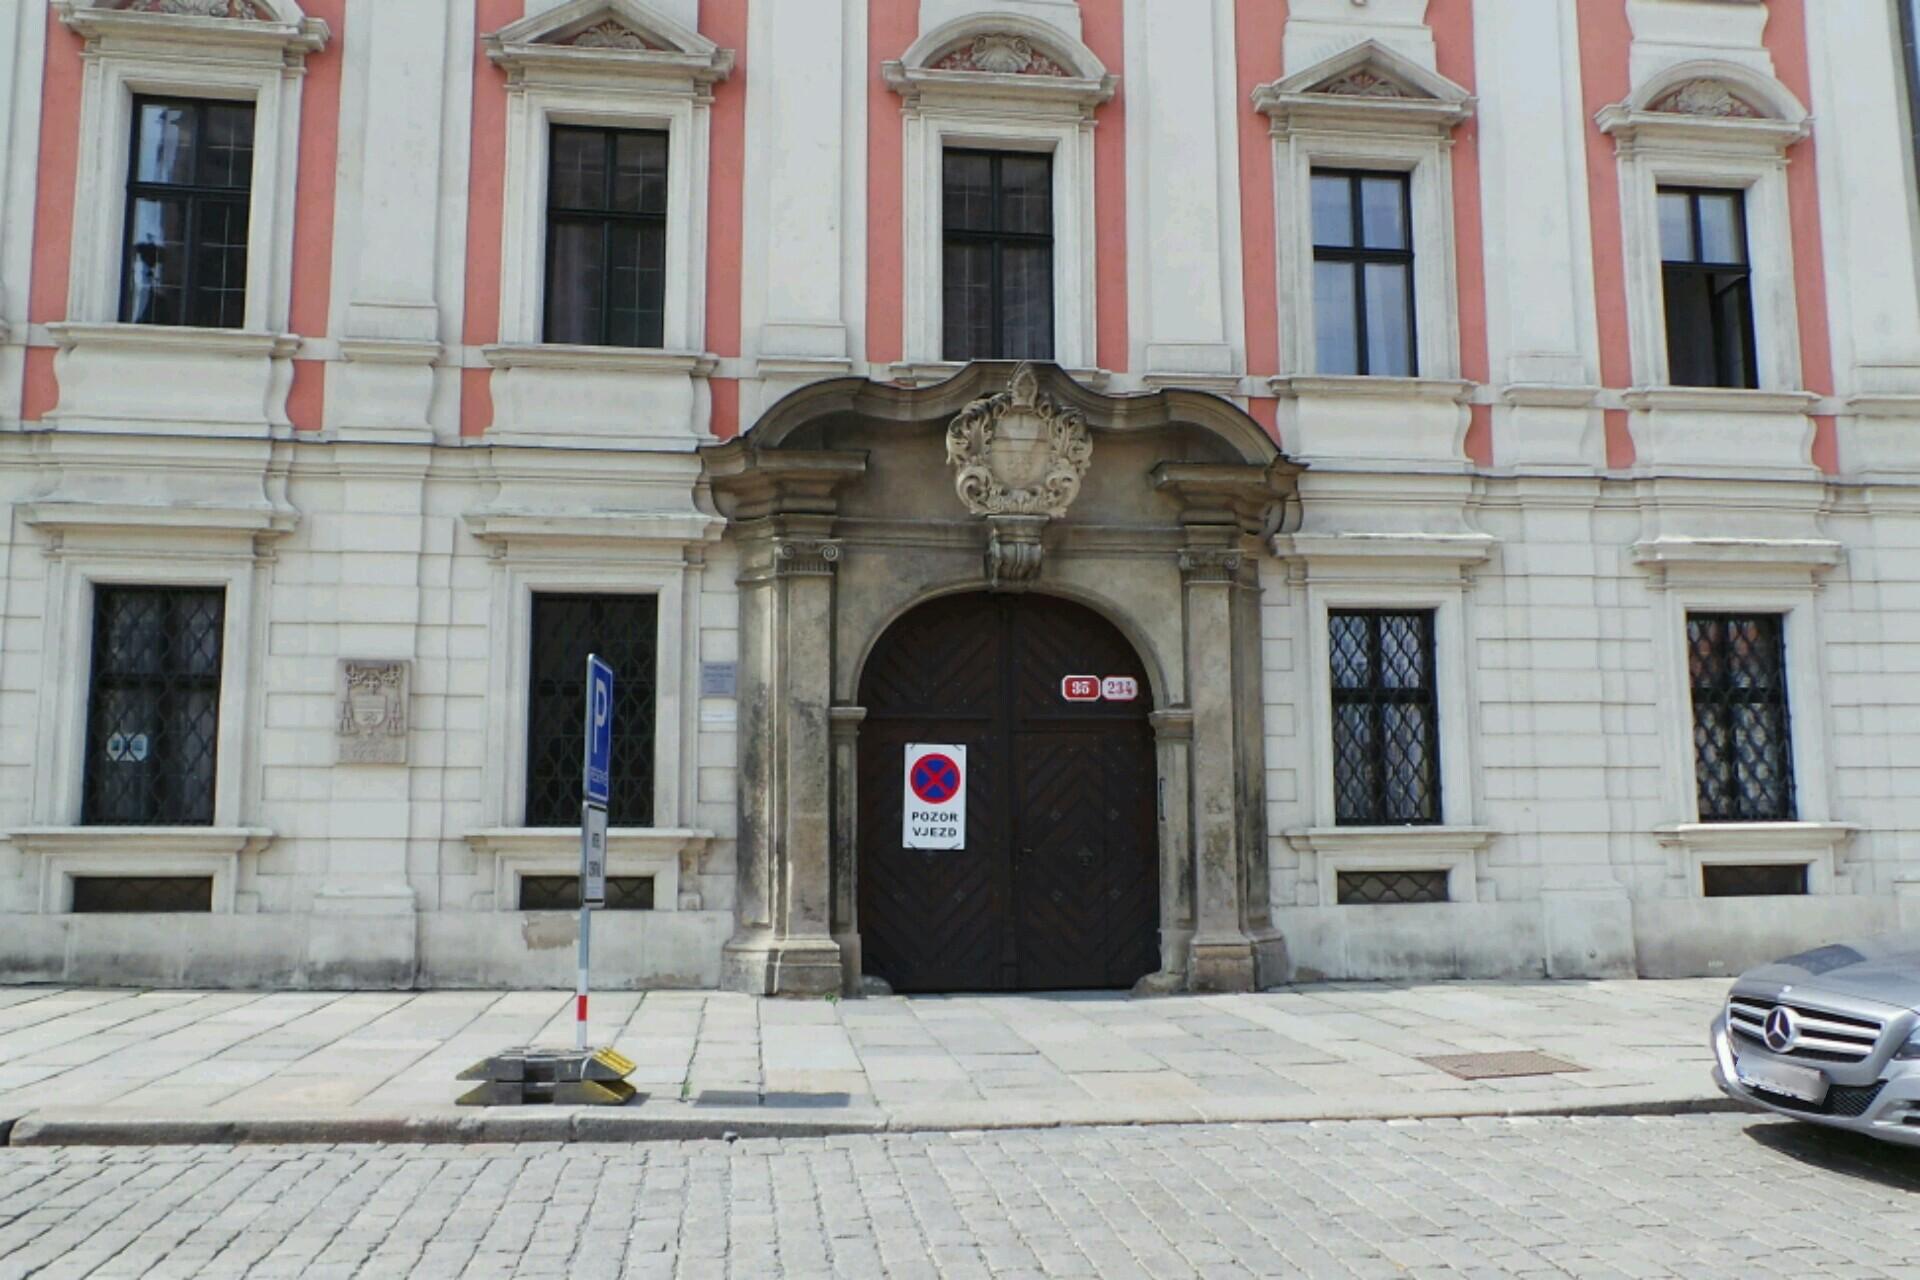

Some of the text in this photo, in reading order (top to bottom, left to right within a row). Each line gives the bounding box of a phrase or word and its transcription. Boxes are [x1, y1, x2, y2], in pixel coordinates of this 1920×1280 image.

[594, 678, 607, 754] P
[912, 811, 958, 822] POZOR
[912, 827, 957, 837] VJEZD
